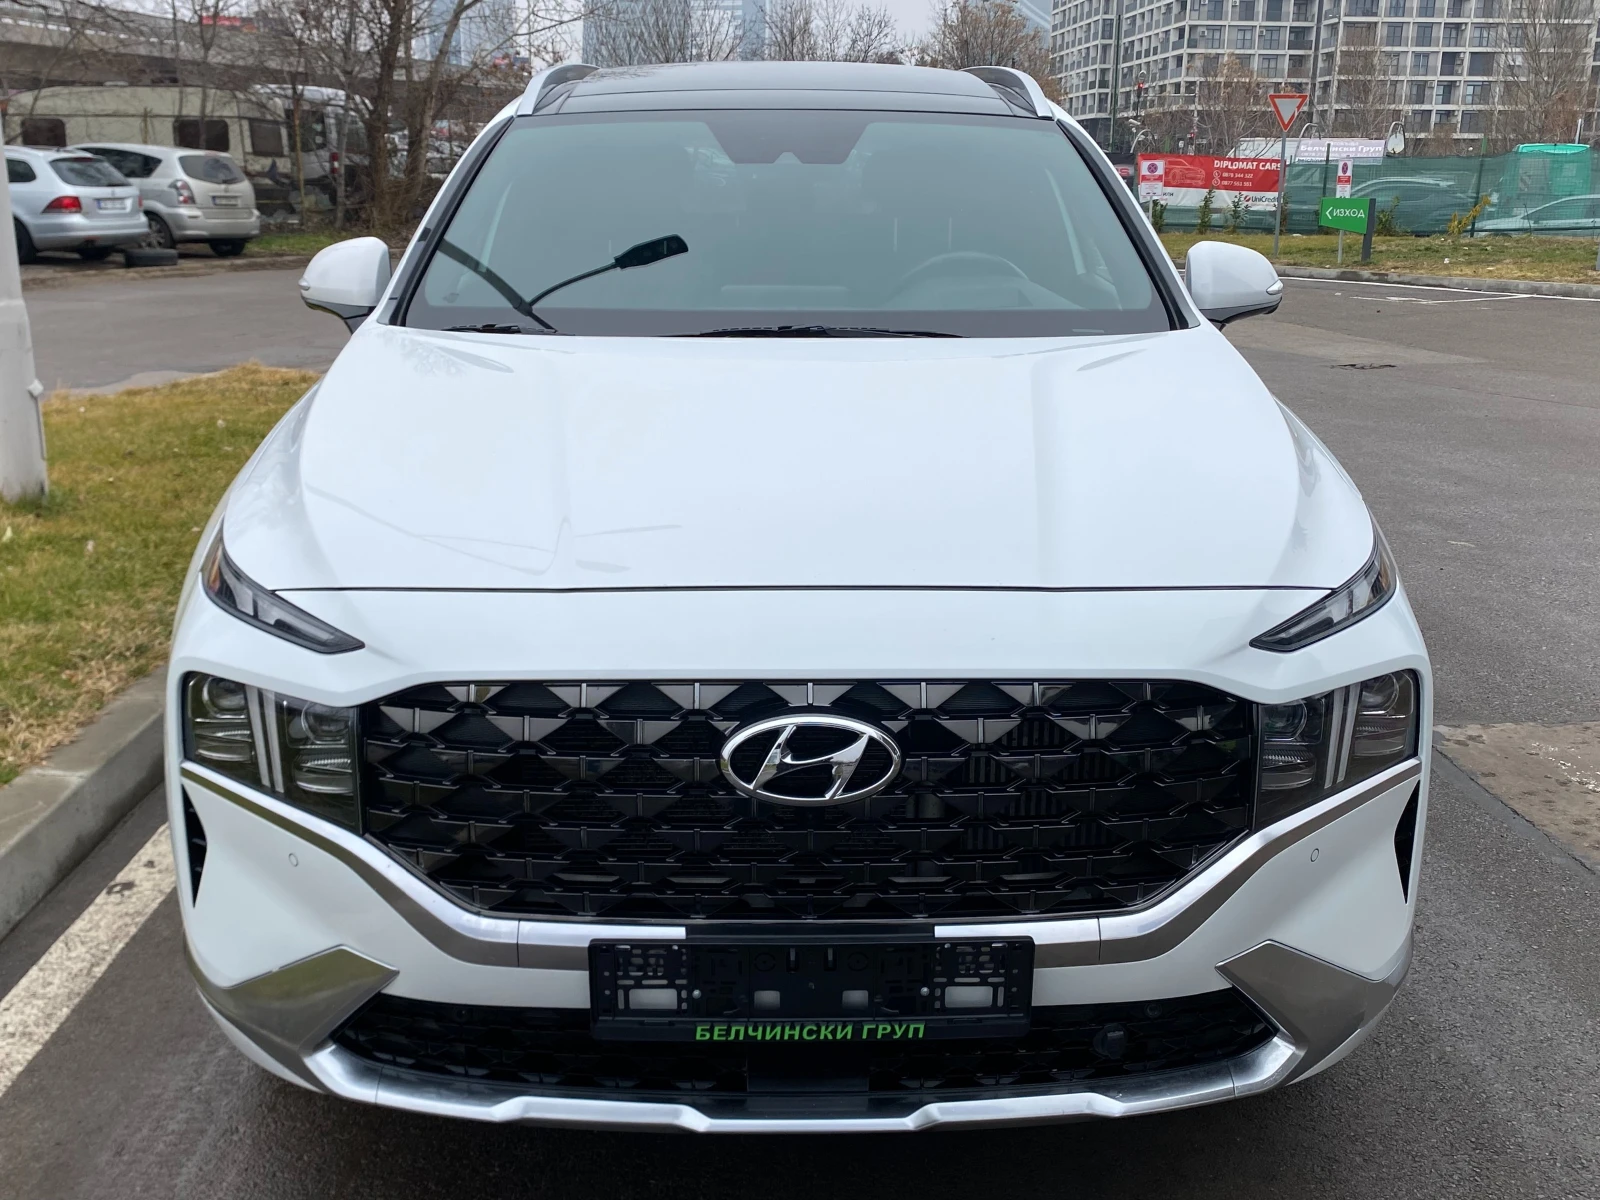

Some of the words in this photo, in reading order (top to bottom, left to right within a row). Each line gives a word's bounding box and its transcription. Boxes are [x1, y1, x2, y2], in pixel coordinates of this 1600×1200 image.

[1214, 160, 1258, 170] DIPLOMAT
[1333, 208, 1364, 218] ИЗХОД
[695, 1025, 853, 1040] БЕЛЧИНСКИ
[861, 1024, 926, 1039] ГРУП
